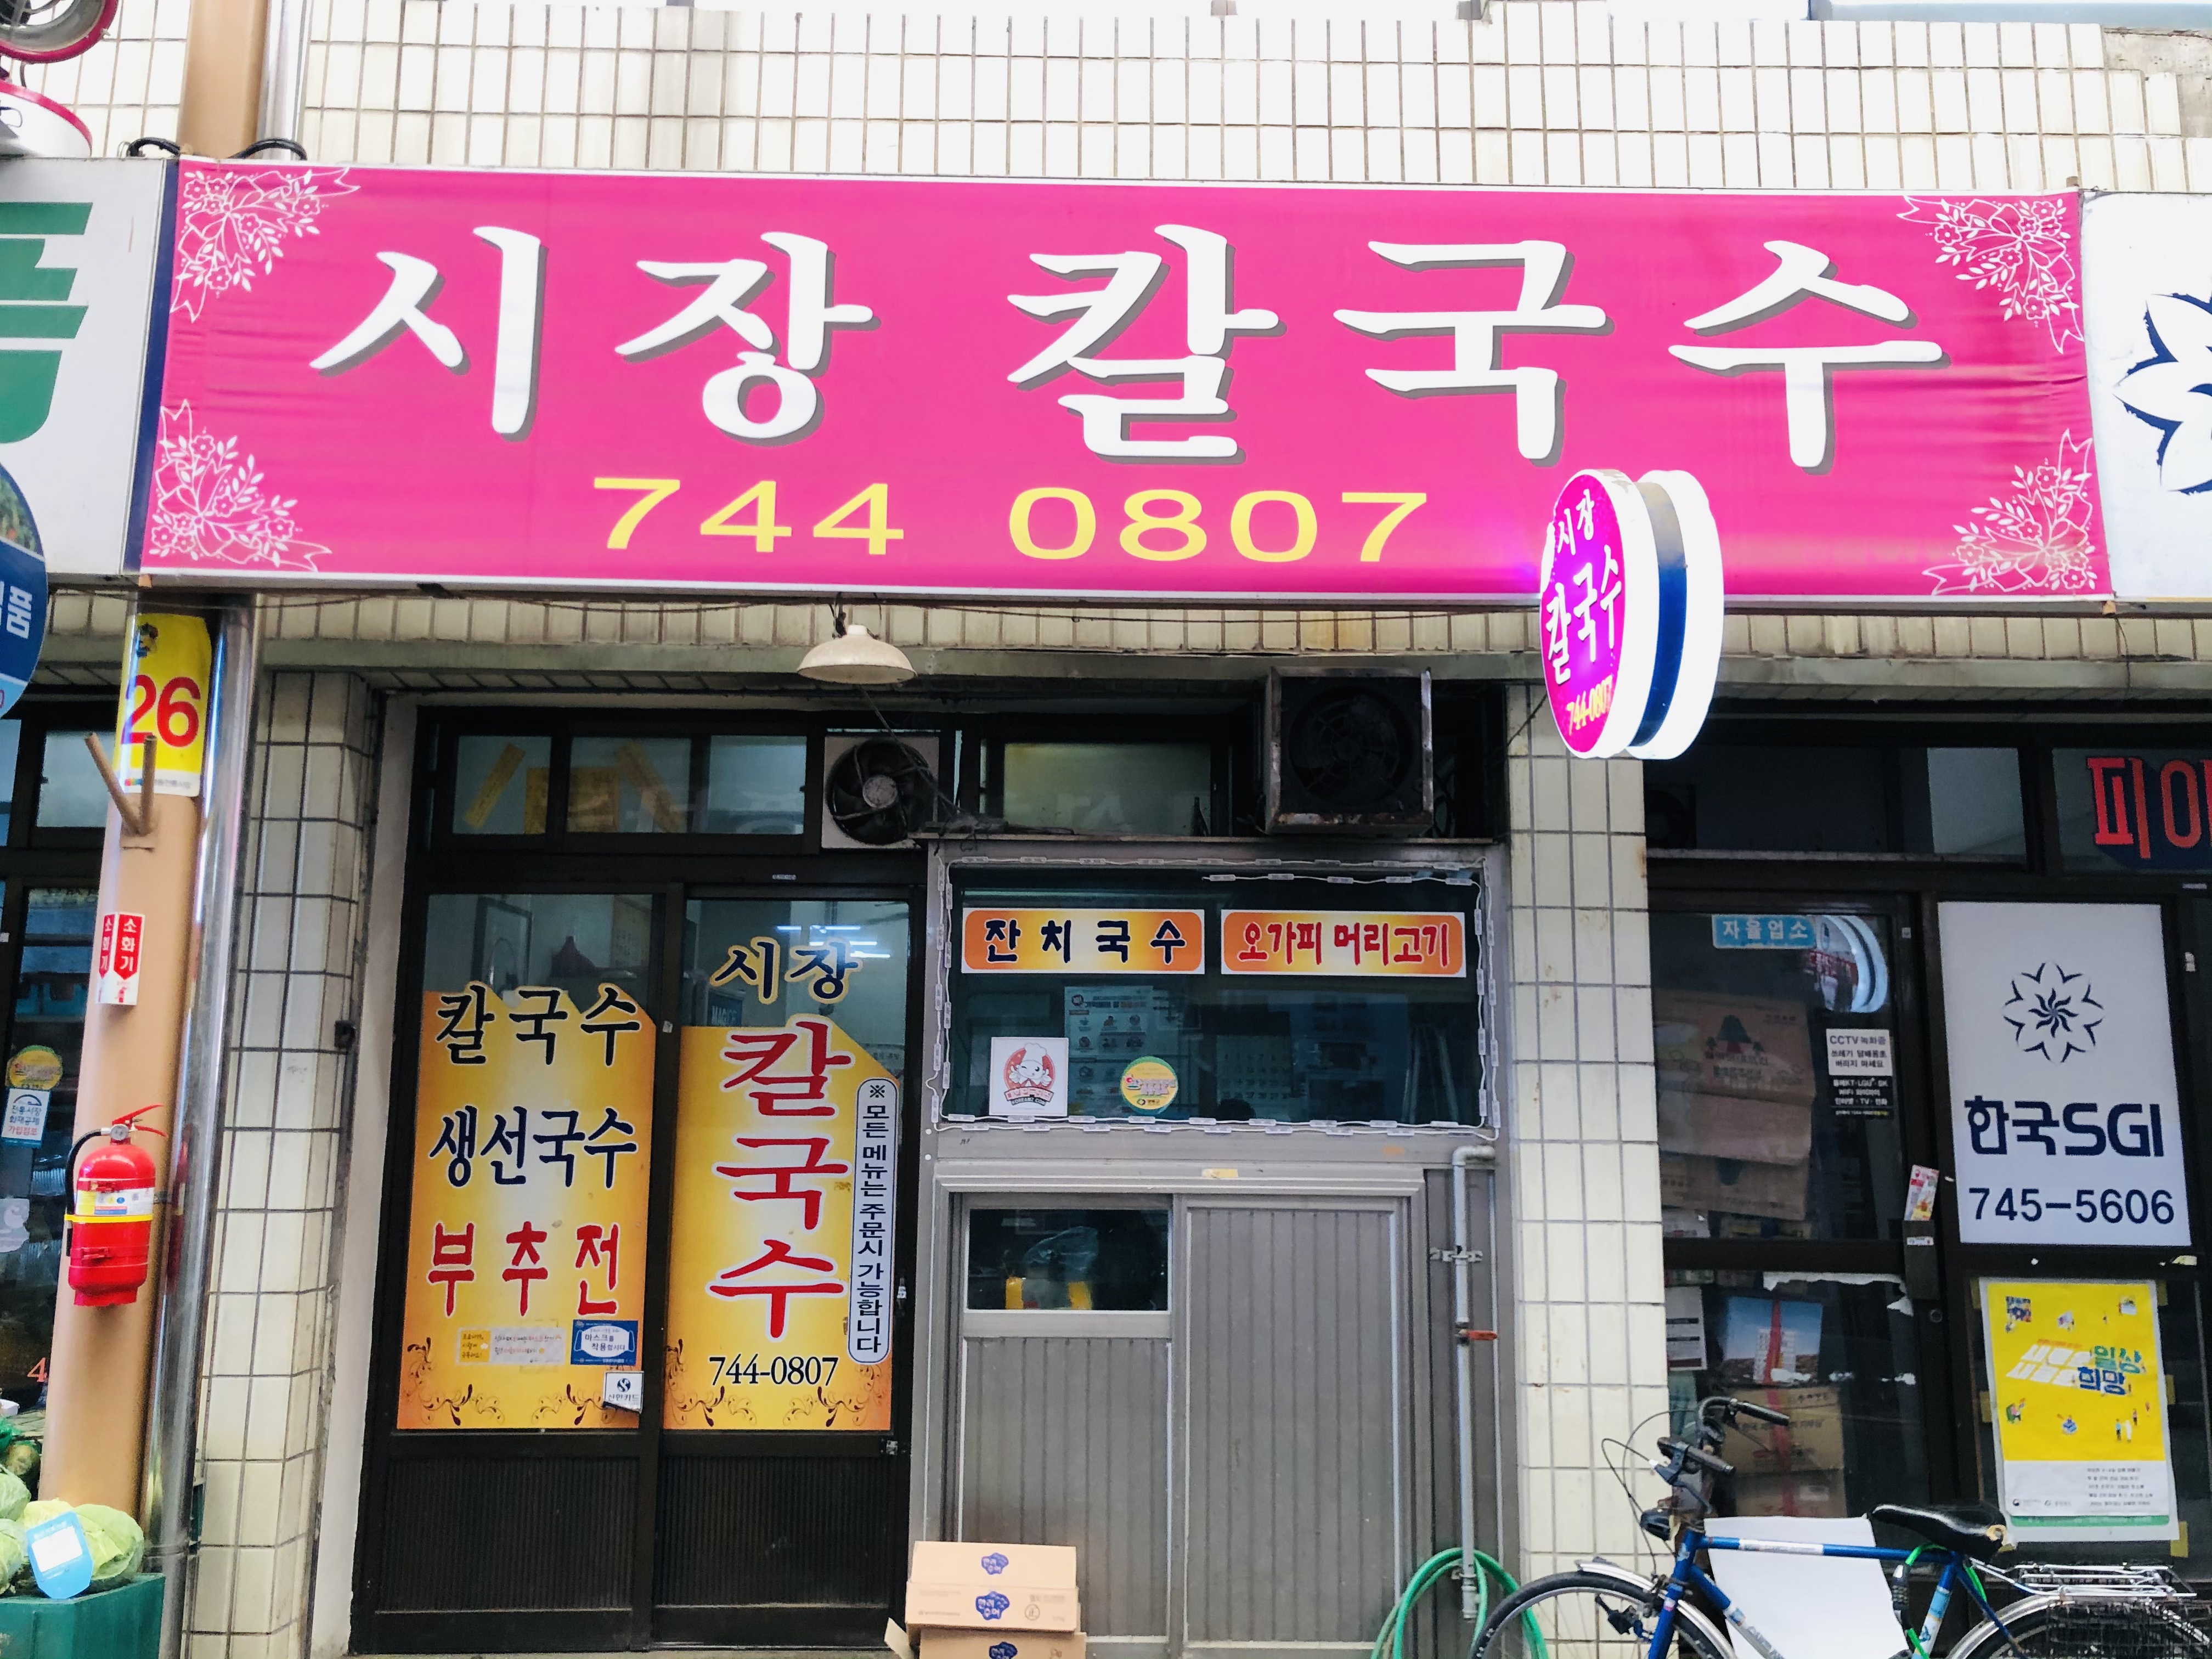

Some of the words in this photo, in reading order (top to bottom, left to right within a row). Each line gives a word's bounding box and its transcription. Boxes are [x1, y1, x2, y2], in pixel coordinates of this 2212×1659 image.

[311, 226, 873, 439] 시장
[1007, 224, 1945, 470] 칼국수
[594, 477, 904, 555] 744
[1009, 487, 1429, 563] 0807
[1557, 489, 1595, 556] 시장
[1545, 544, 1622, 685] 칼국수
[122, 674, 201, 747] 26
[1566, 675, 1613, 736] 744-0807
[120, 918, 137, 972] 소화기
[985, 919, 1187, 964] 잔치국수
[1238, 921, 1323, 966] 오가피
[1333, 922, 1451, 968] 머리고기
[1723, 919, 1809, 940] 자율업소
[714, 940, 860, 1000] 시장
[436, 984, 641, 1066] 칼국수
[1830, 1036, 1859, 1045] CCTV
[12, 1105, 42, 1117] 전통시장
[863, 1105, 890, 1139] 모든
[1964, 1095, 2164, 1158] 한국SGI
[429, 1105, 637, 1188] 생선국수
[860, 1144, 889, 1197] 메뉴는
[709, 1021, 853, 1338] 칼국수
[1968, 1187, 2175, 1225] 745-5606
[857, 1203, 887, 1257] 주문시
[428, 1221, 620, 1316] 부추전
[856, 1262, 884, 1354] 가능합니다
[585, 1334, 614, 1342] 마스크를
[591, 1342, 625, 1351] 착용합시다
[2094, 1345, 2142, 1374] 일상
[709, 1353, 839, 1386] 744-0807
[2077, 1366, 2127, 1395] 희망
[608, 1393, 640, 1402] 신한카드
